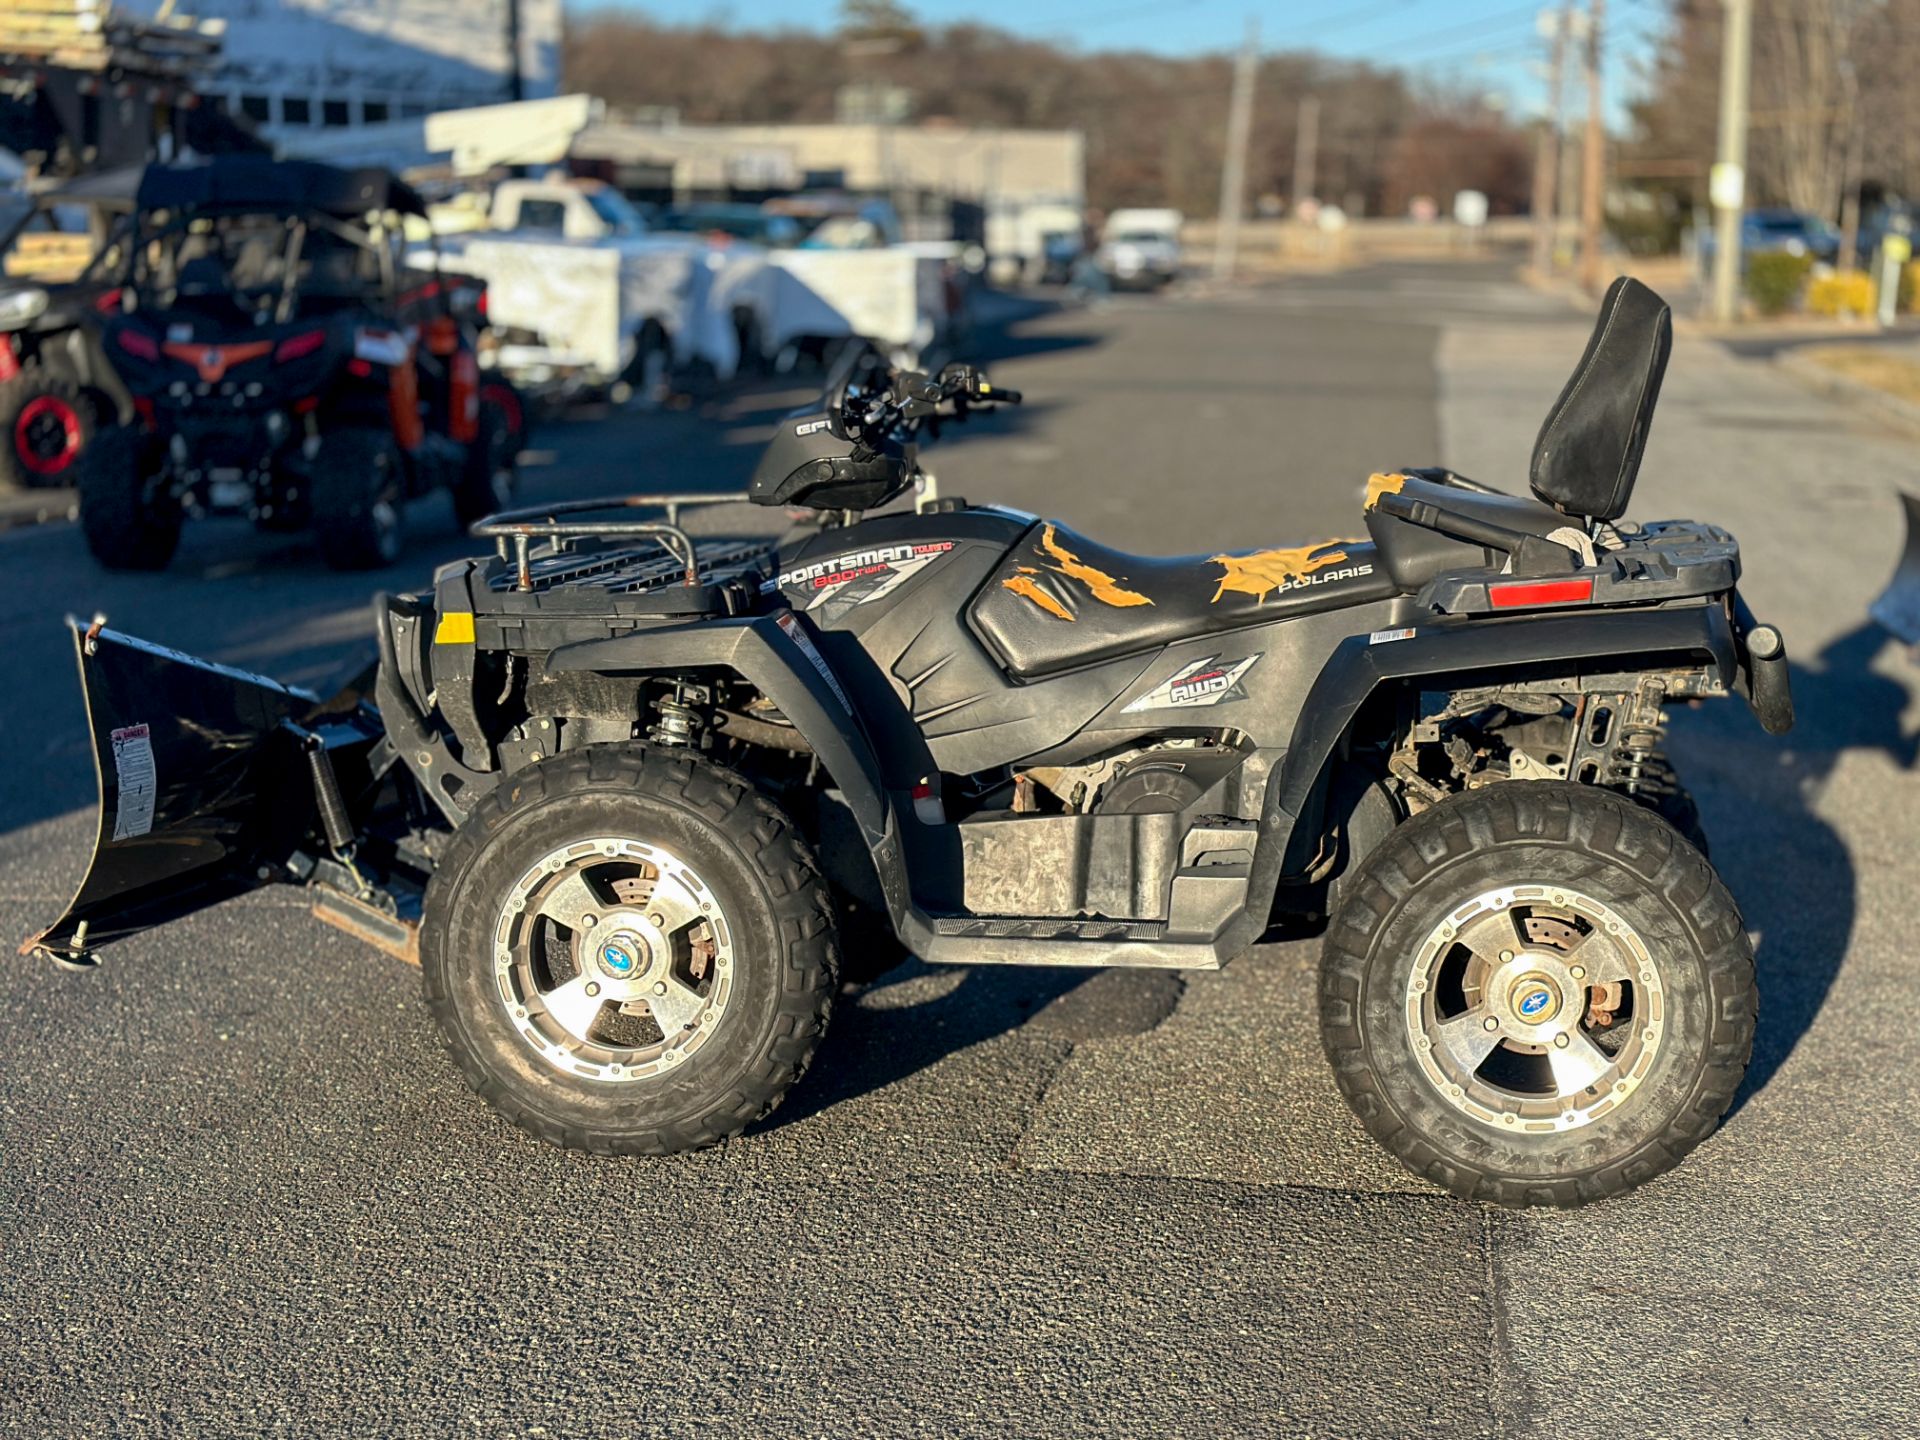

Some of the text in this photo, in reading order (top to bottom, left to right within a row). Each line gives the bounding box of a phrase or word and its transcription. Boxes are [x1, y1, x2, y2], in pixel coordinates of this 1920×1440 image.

[759, 545, 913, 592] SPORTSMAN
[813, 563, 888, 588] 800 TWIN
[1278, 564, 1373, 594] POLARIS
[1170, 676, 1228, 702] AWD
